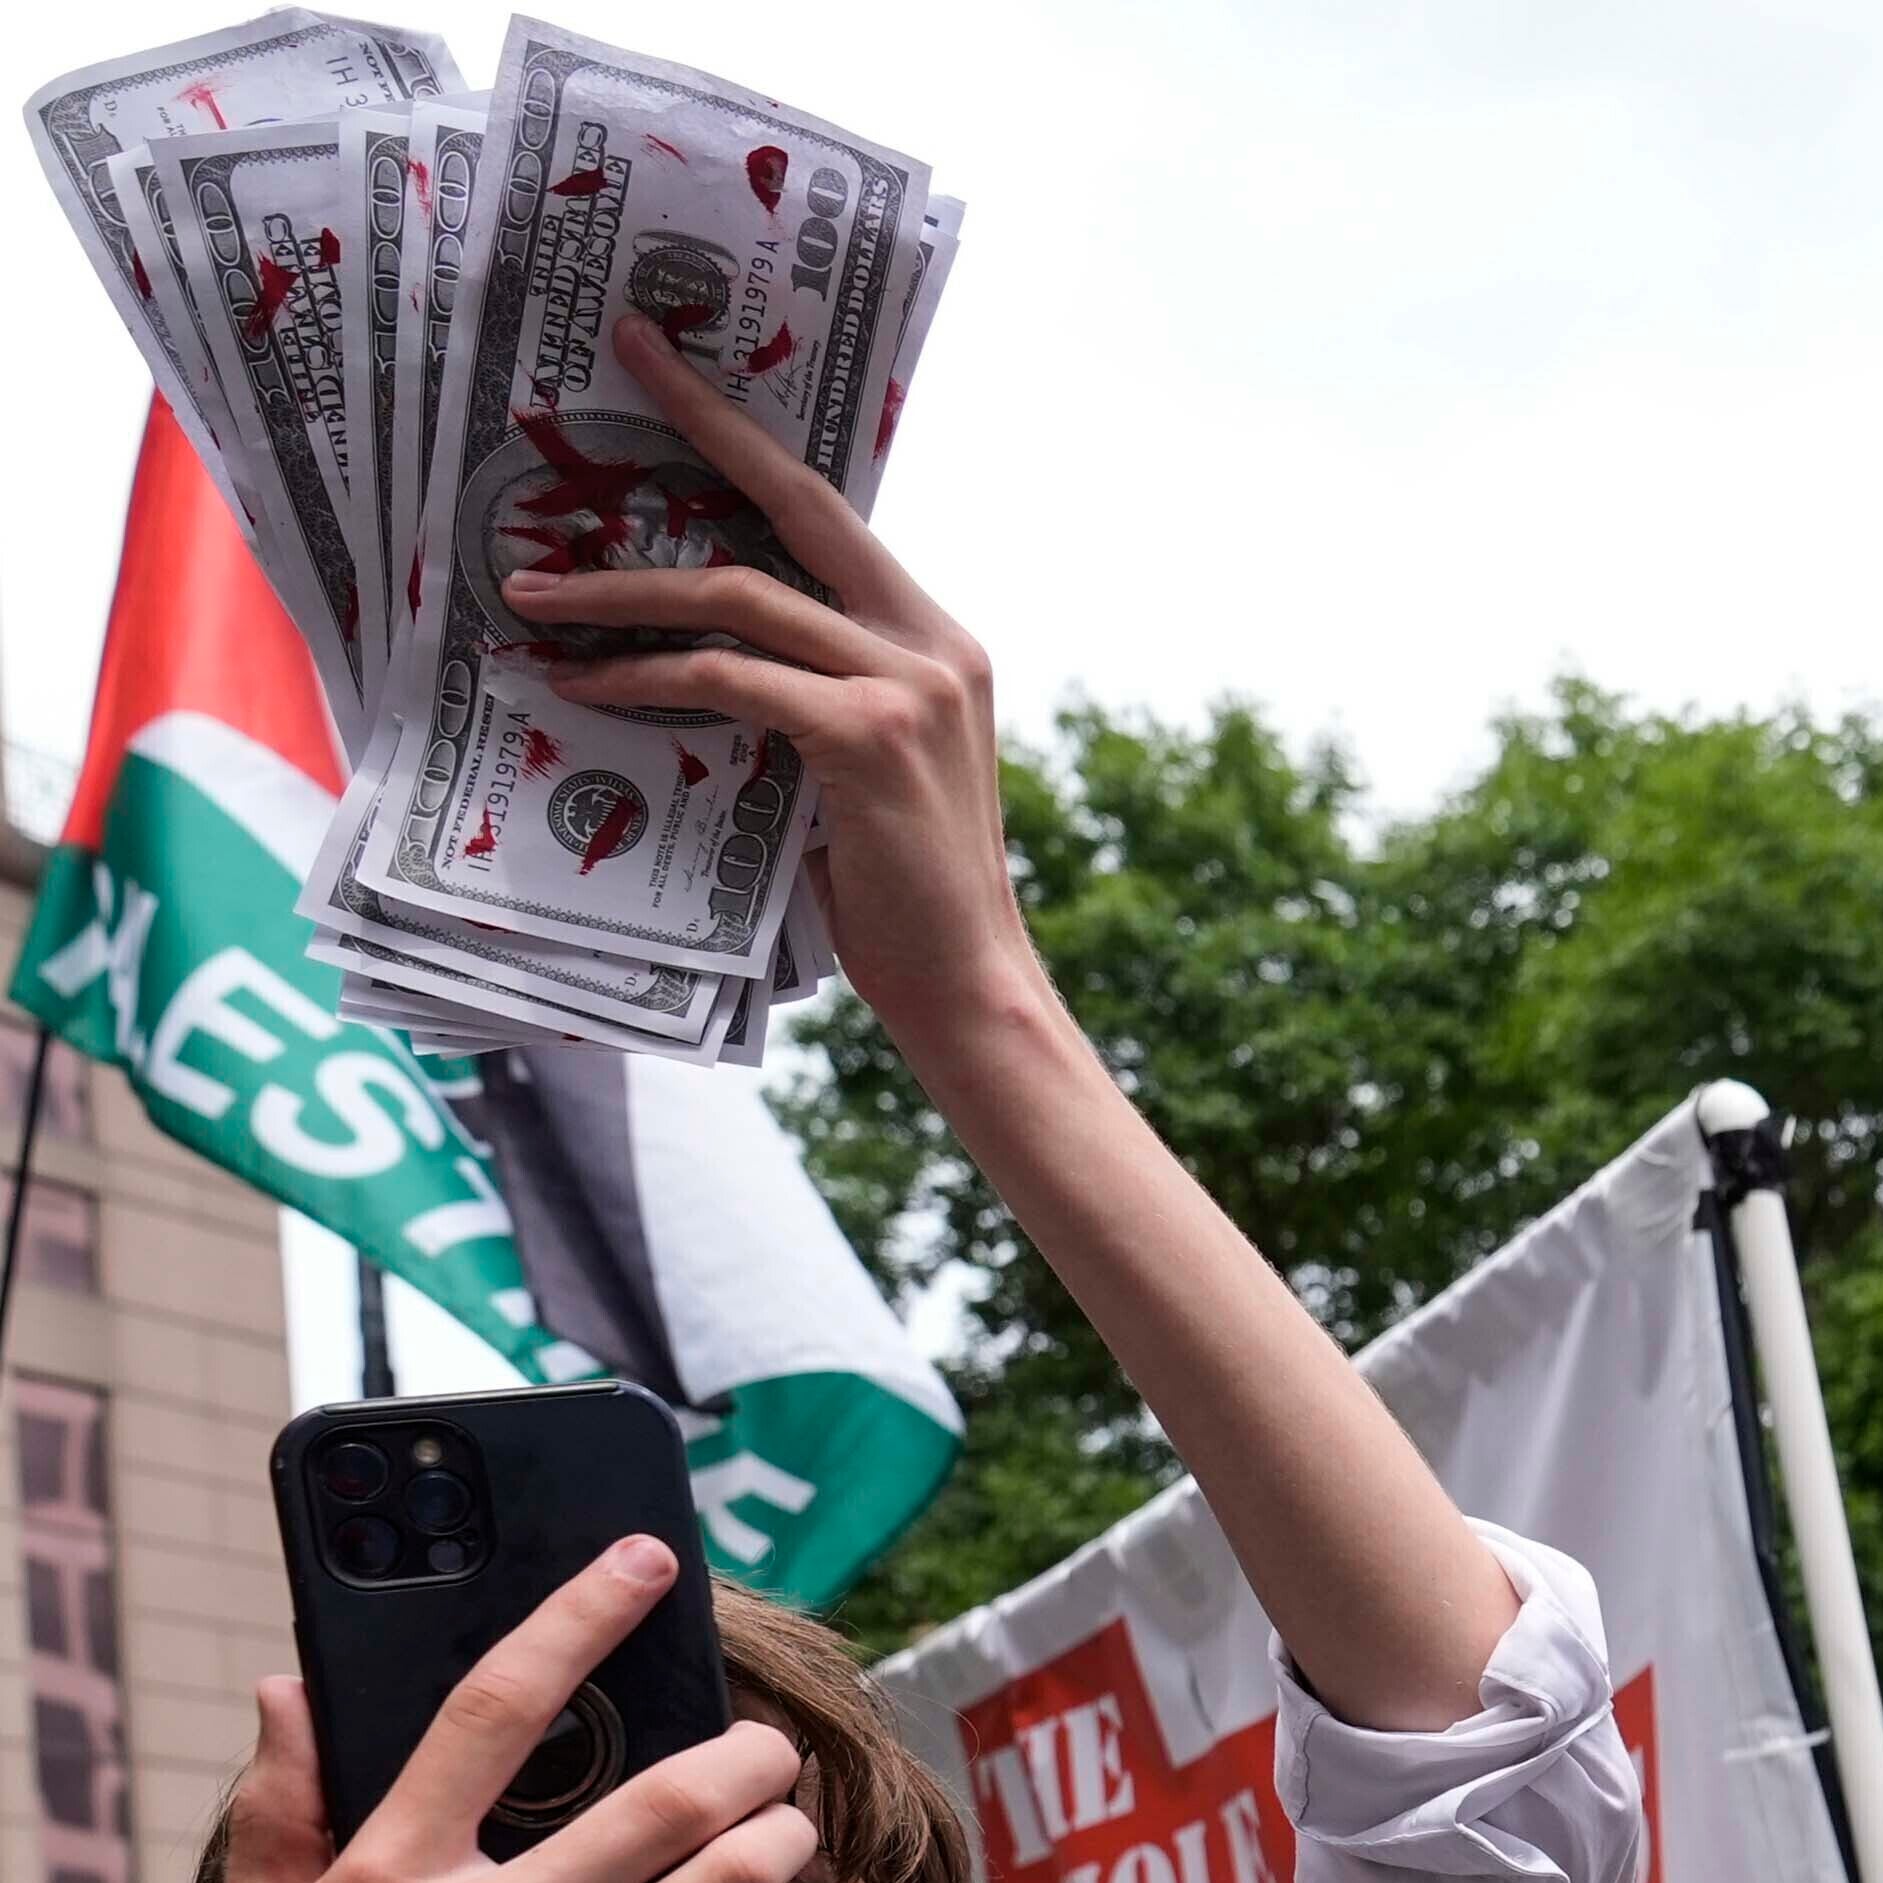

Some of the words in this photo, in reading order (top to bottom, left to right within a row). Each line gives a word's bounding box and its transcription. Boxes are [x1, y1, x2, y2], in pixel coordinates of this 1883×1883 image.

[530, 214, 561, 297] THE
[790, 166, 850, 302] 100
[560, 335, 595, 393] OF
[813, 308, 861, 467] HUNDRED
[845, 177, 890, 310] DOLLARS
[441, 835, 458, 869] NOT
[451, 752, 482, 832] FEDERAL
